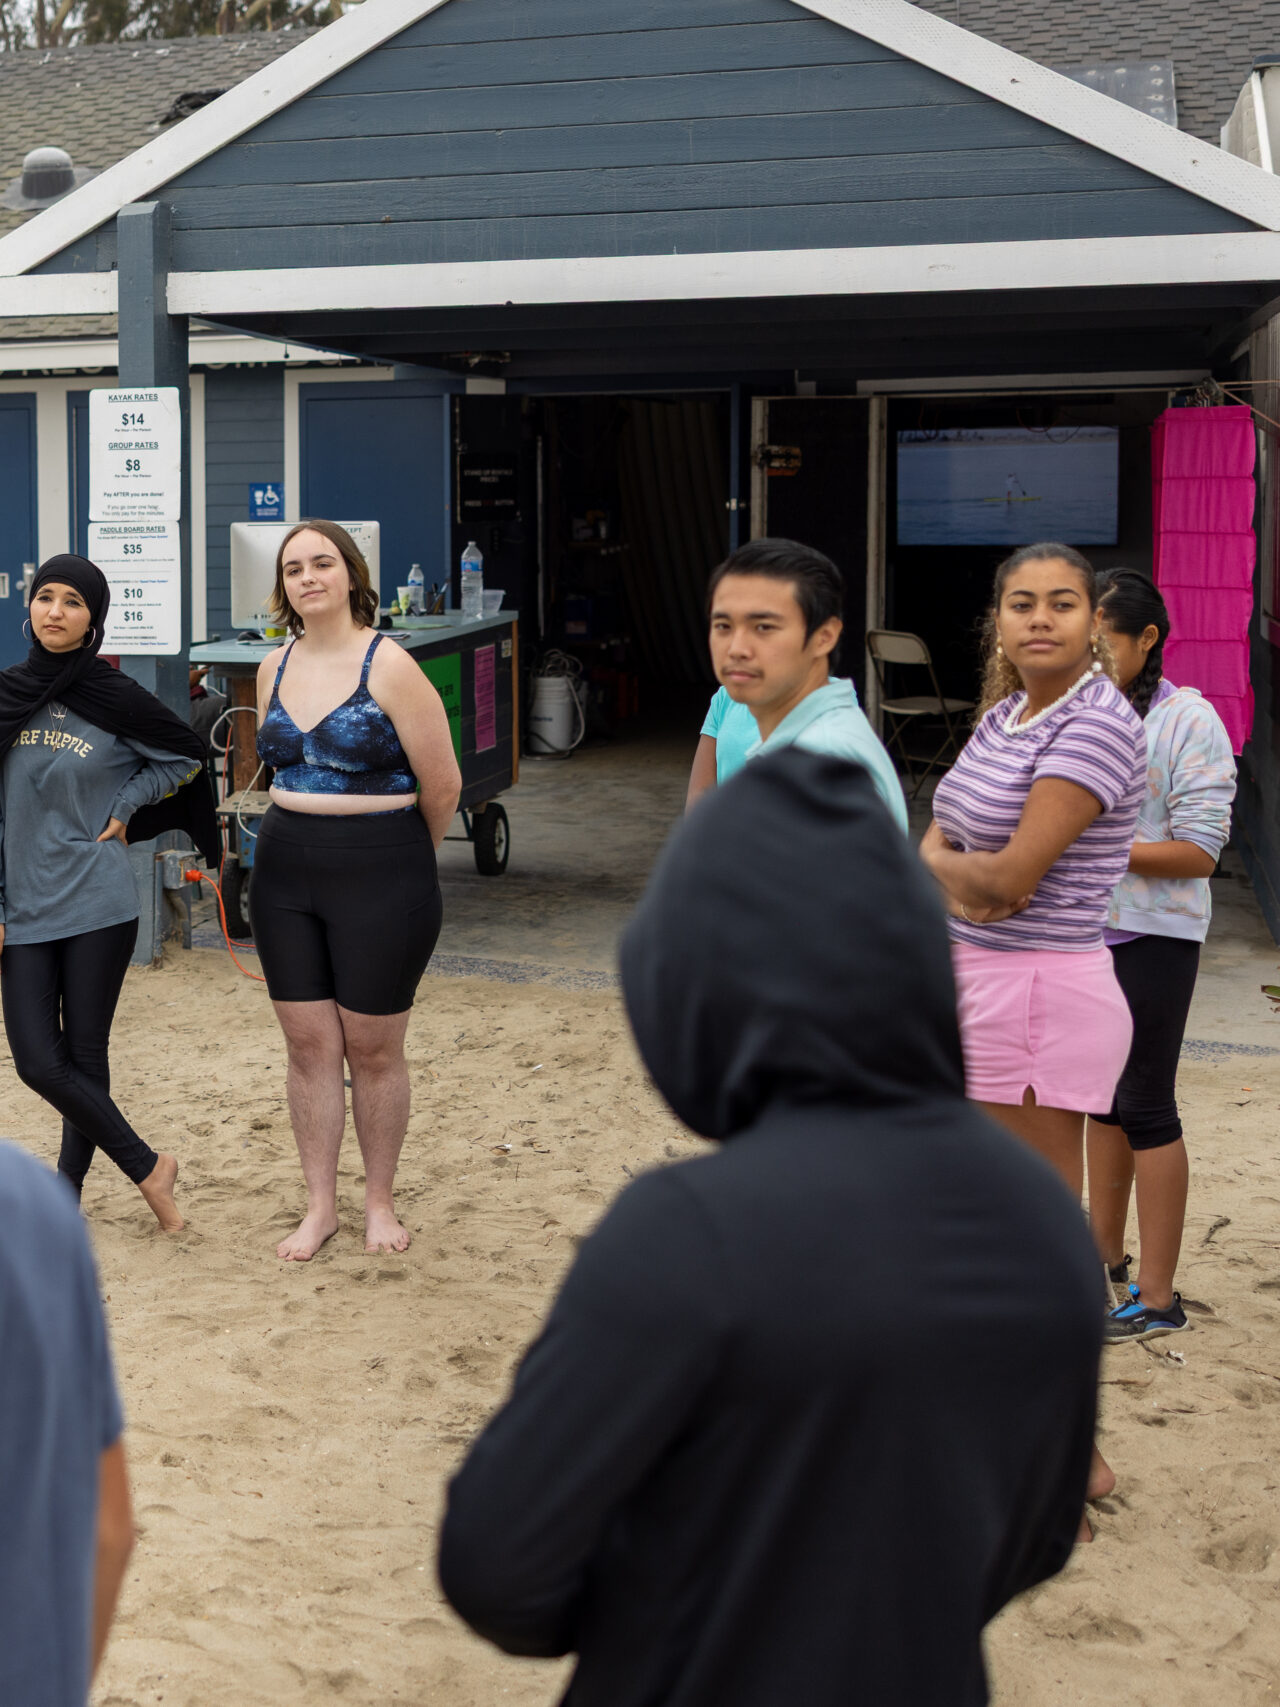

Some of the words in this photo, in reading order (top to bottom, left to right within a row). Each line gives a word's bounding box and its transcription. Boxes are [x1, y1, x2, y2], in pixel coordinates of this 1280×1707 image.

[108, 394, 133, 402] KAYAK
[134, 393, 159, 401] RATES
[121, 412, 145, 426] $14
[108, 442, 133, 450] GROUP
[134, 441, 159, 449] RATES
[125, 458, 141, 472] $8
[145, 525, 166, 533] RATES
[123, 544, 142, 555] $35
[124, 588, 143, 599] $10
[124, 611, 143, 622] $16
